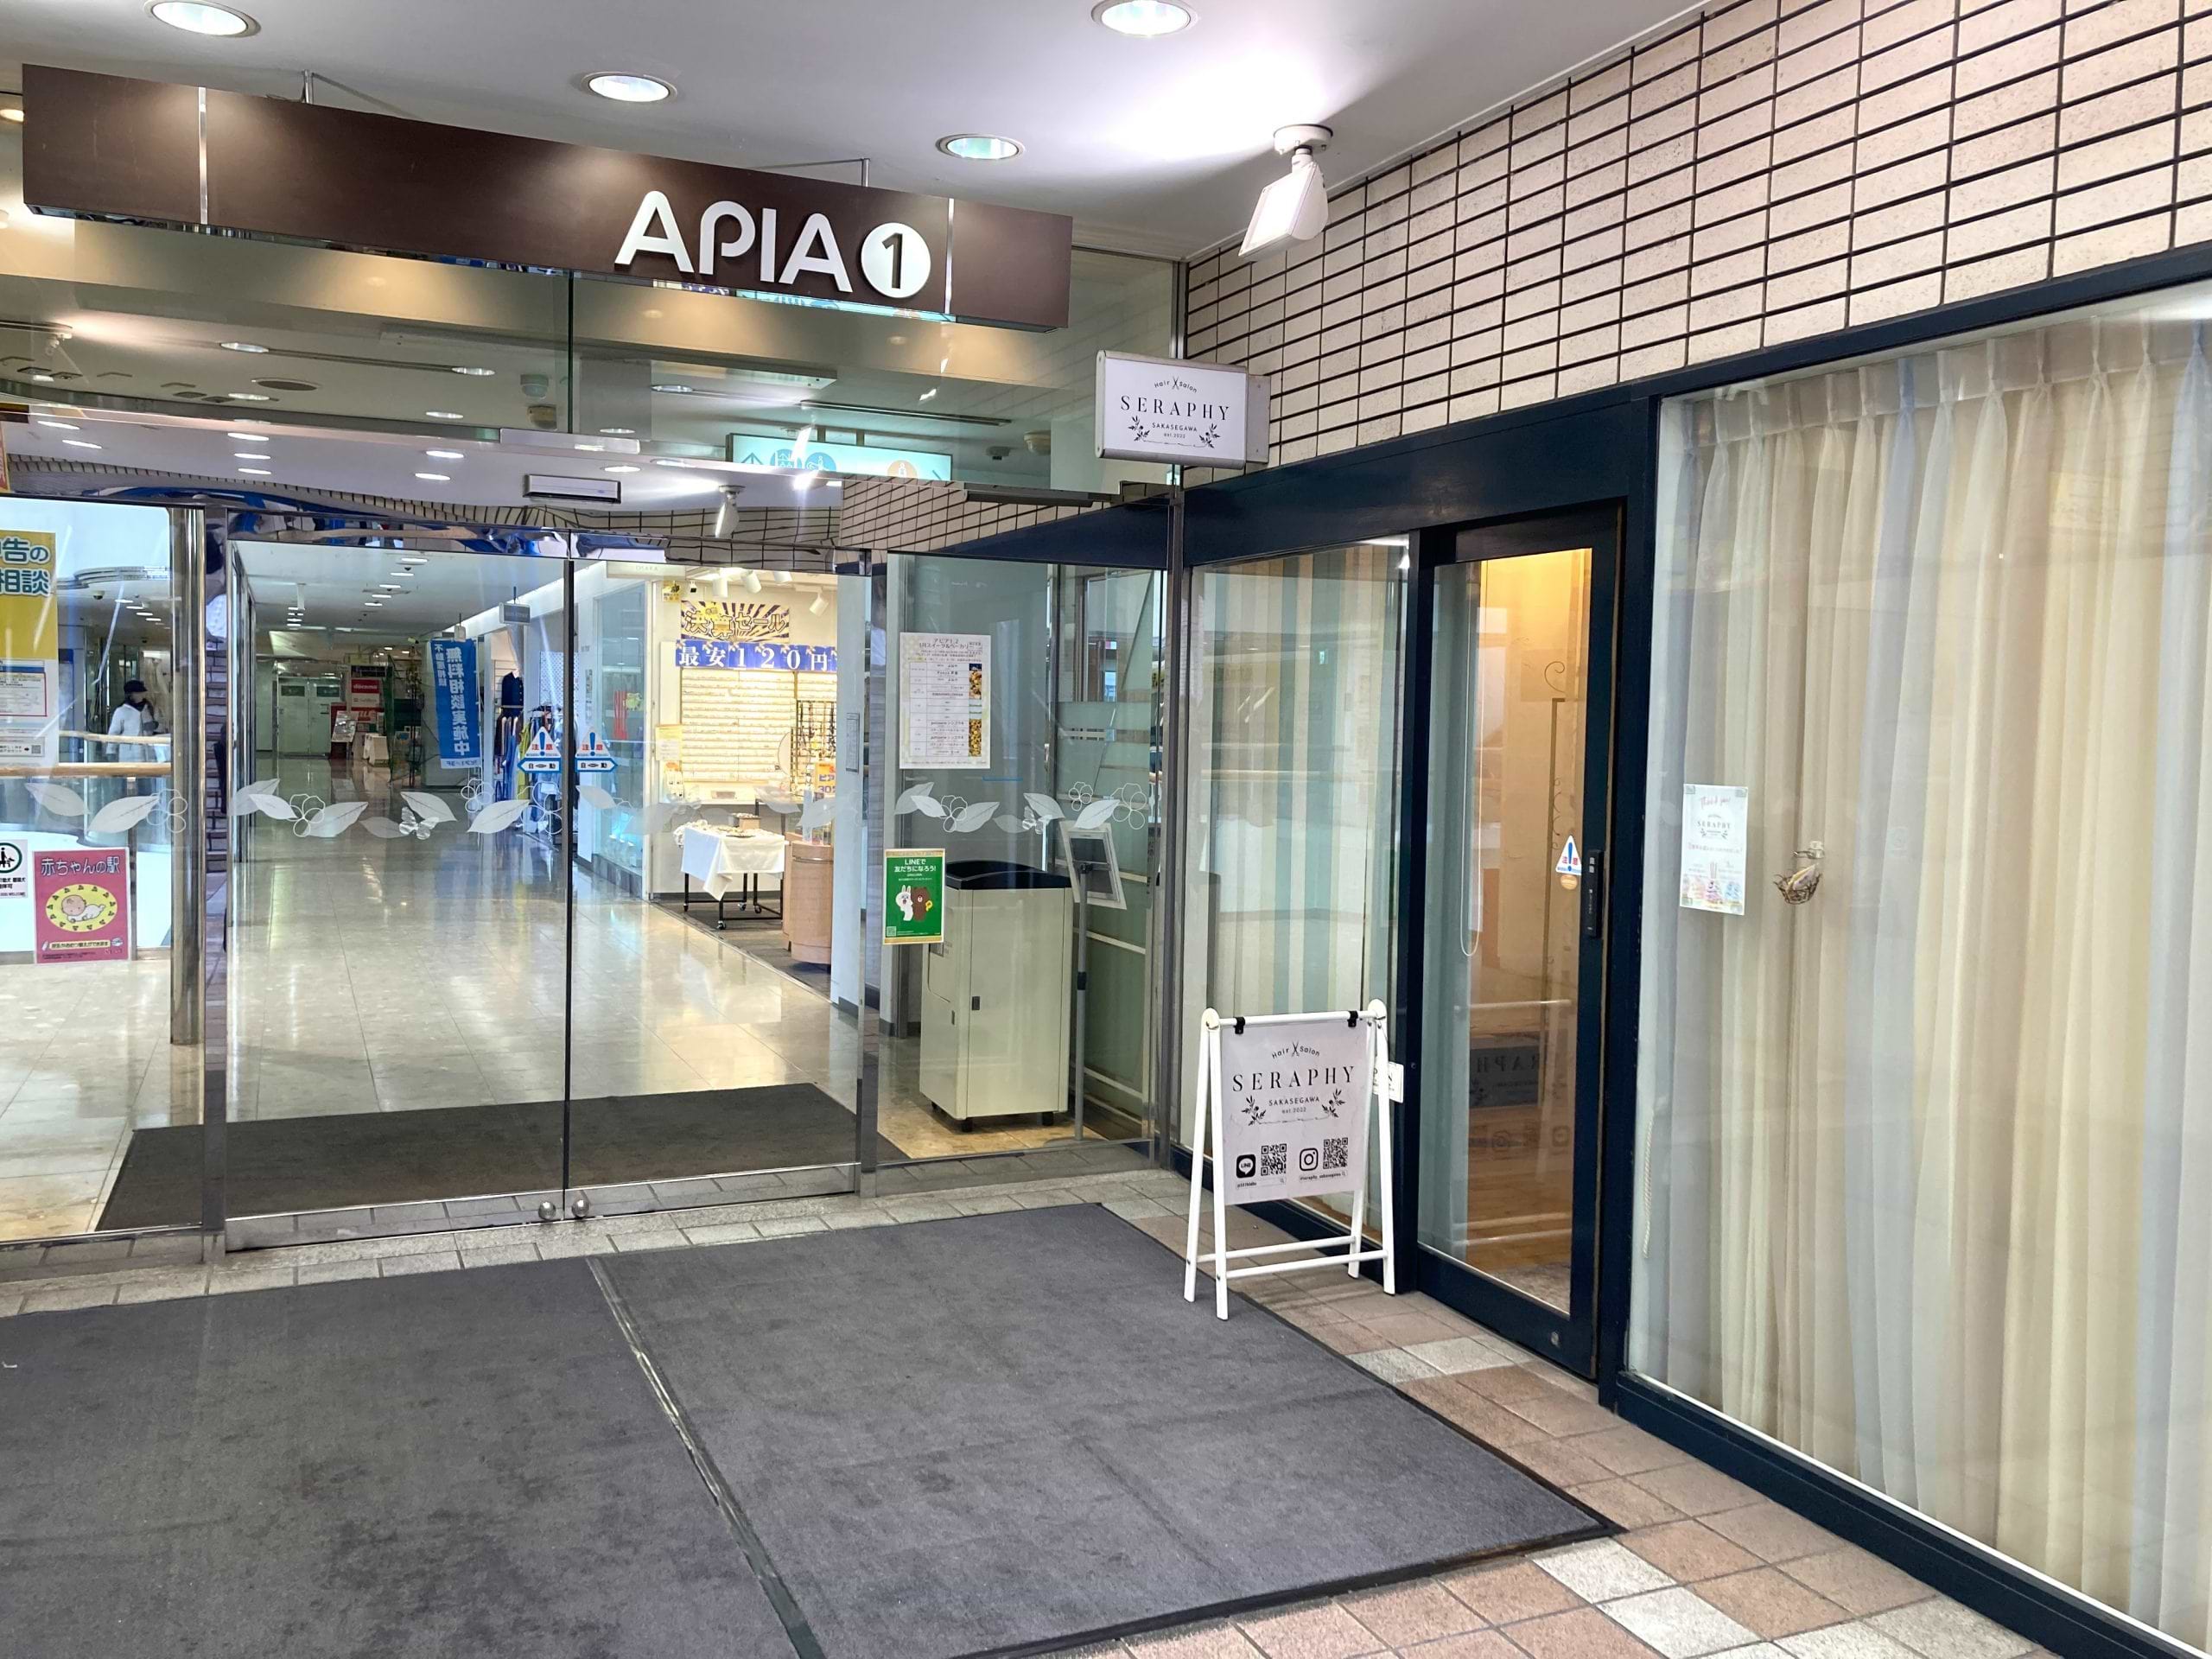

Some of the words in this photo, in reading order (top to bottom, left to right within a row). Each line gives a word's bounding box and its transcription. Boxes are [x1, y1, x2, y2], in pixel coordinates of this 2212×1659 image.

[614, 190, 853, 293] APIA
[1179, 381, 1198, 393] Salon
[1121, 395, 1230, 421] SERAPHY
[1152, 422, 1198, 432] SAKASEGAWA
[0, 537, 49, 562] 告の
[41, 855, 120, 876] 赤ちゃんの駅
[1272, 1048, 1289, 1059] Hair
[1300, 1046, 1320, 1057] Salon
[1232, 1065, 1354, 1092] SERAPHY
[1268, 1096, 1319, 1106] SAKASEGAWA
